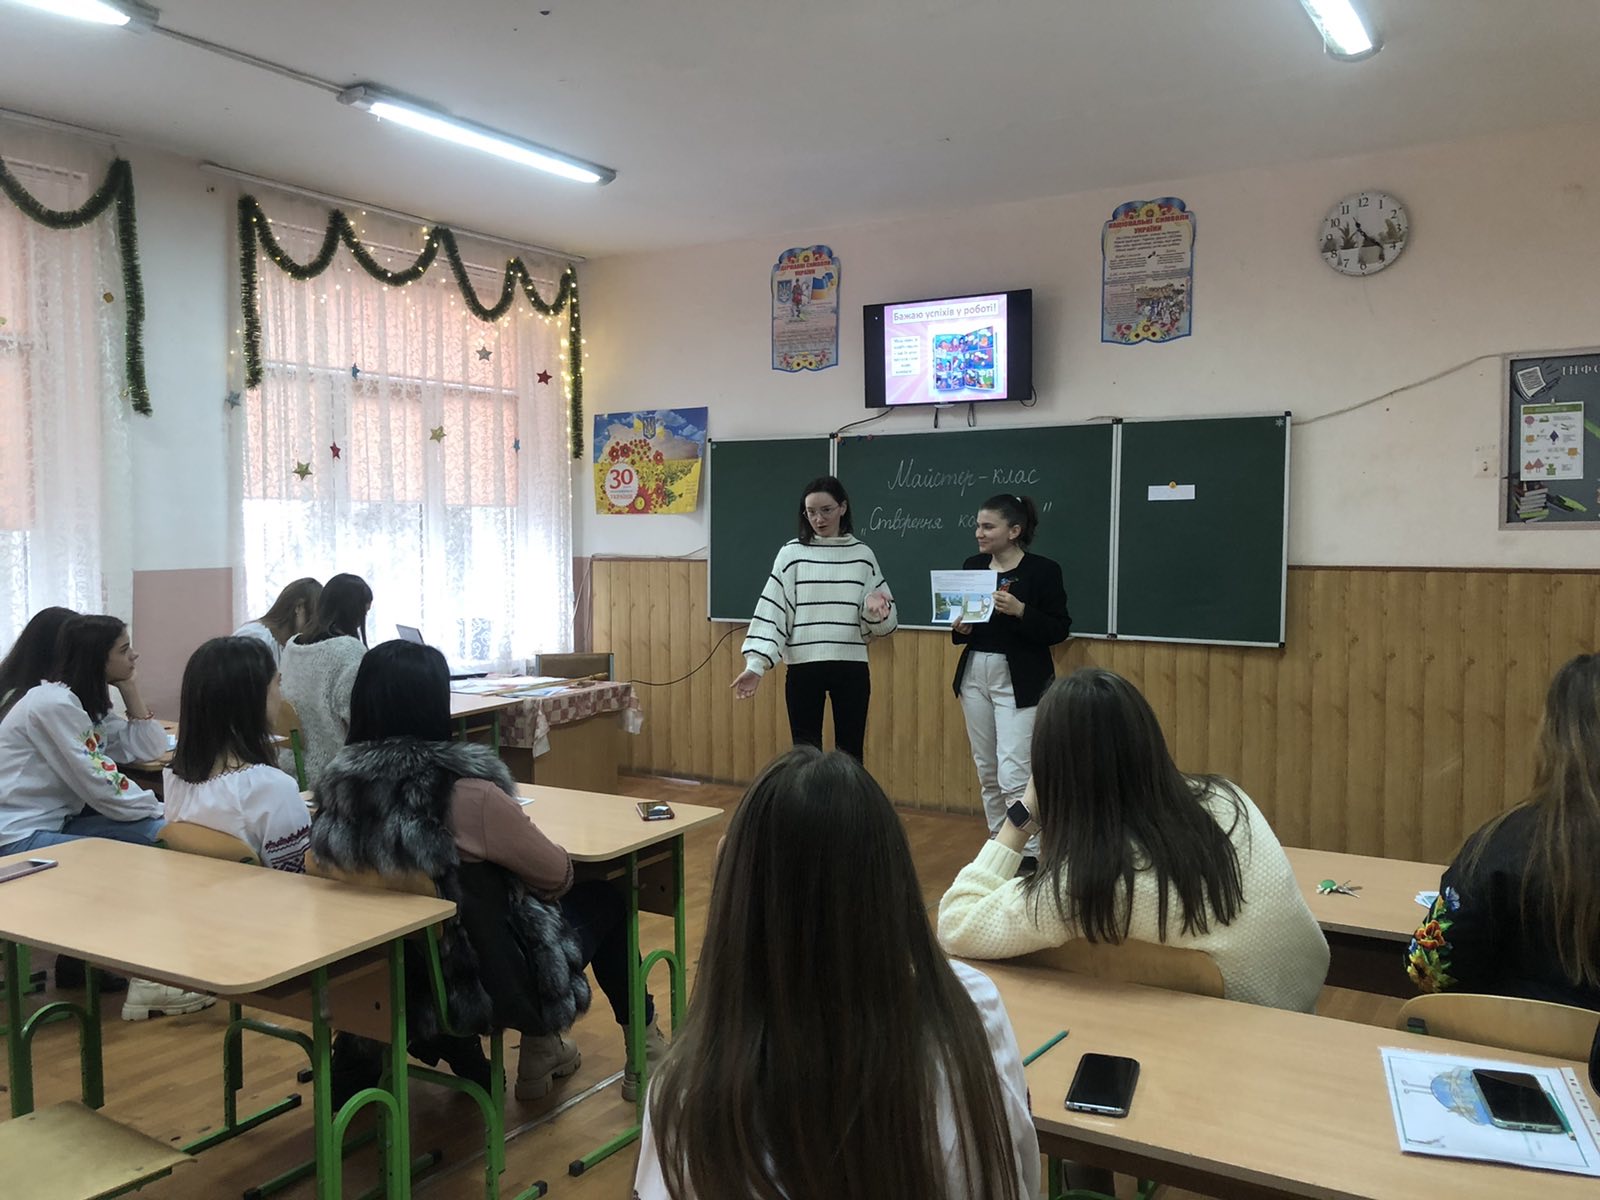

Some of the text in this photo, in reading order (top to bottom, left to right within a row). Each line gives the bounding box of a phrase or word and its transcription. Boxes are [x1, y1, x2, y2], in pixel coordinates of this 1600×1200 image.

[1358, 197, 1369, 208] 12
[1379, 199, 1383, 209] 1
[1341, 205, 1350, 215] 11
[1390, 209, 1397, 219] 2
[1330, 217, 1340, 228] 10
[1396, 223, 1402, 232] 3
[1330, 249, 1338, 258] 8
[1343, 258, 1350, 268] 7
[893, 303, 996, 321] Бажаю успіхів у роботі!
[609, 468, 634, 490] 30
